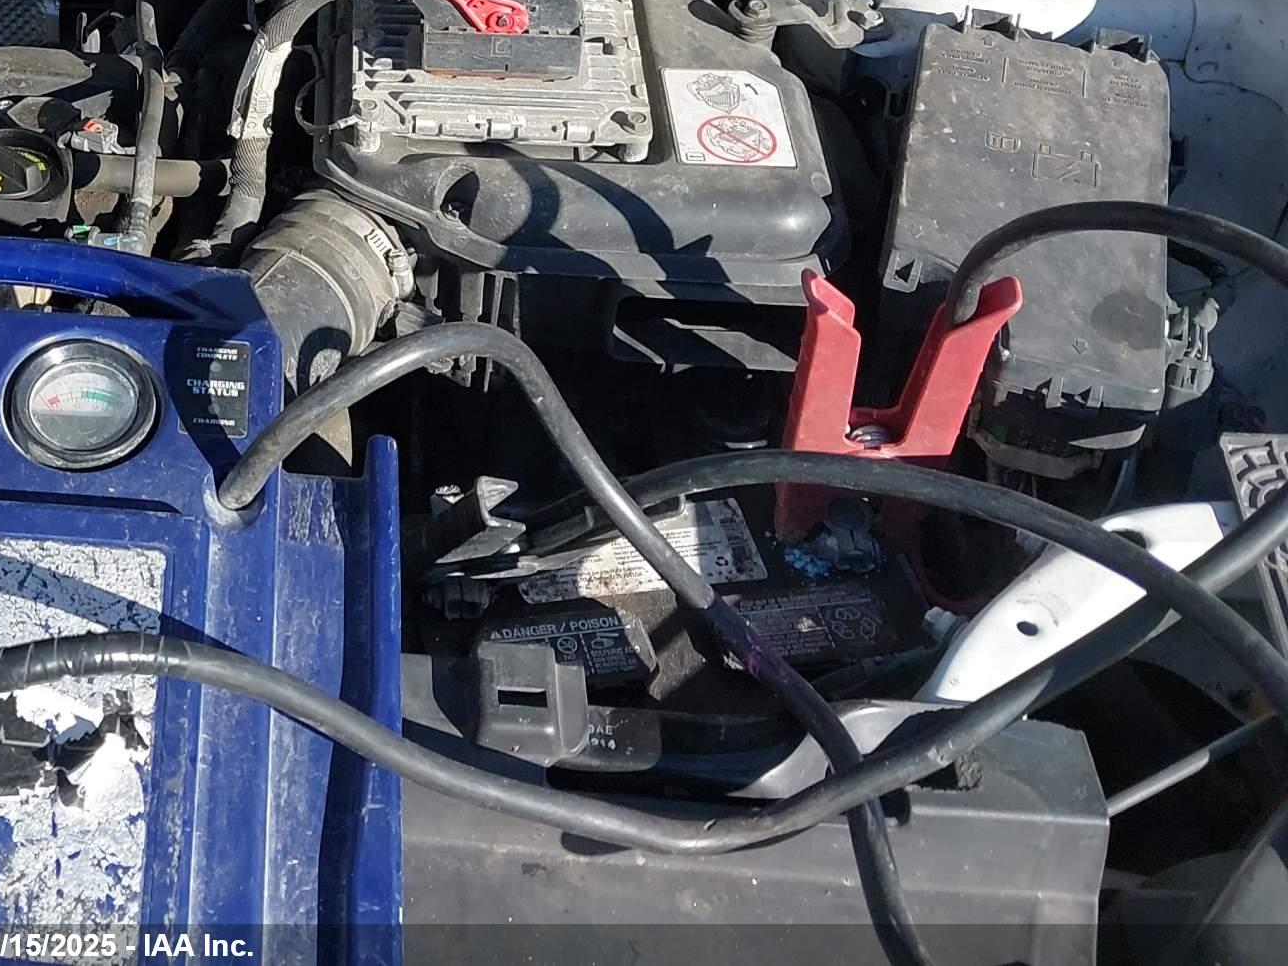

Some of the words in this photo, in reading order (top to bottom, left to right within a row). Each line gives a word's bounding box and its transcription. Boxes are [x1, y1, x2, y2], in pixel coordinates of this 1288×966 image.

[197, 346, 238, 354] CHARGING
[196, 352, 238, 360] COMPLETE
[186, 378, 245, 390] CHARGING
[192, 387, 239, 397] STATUS
[193, 417, 236, 426] CHARGING
[502, 624, 557, 639] DANGER
[569, 616, 619, 631] POISON
